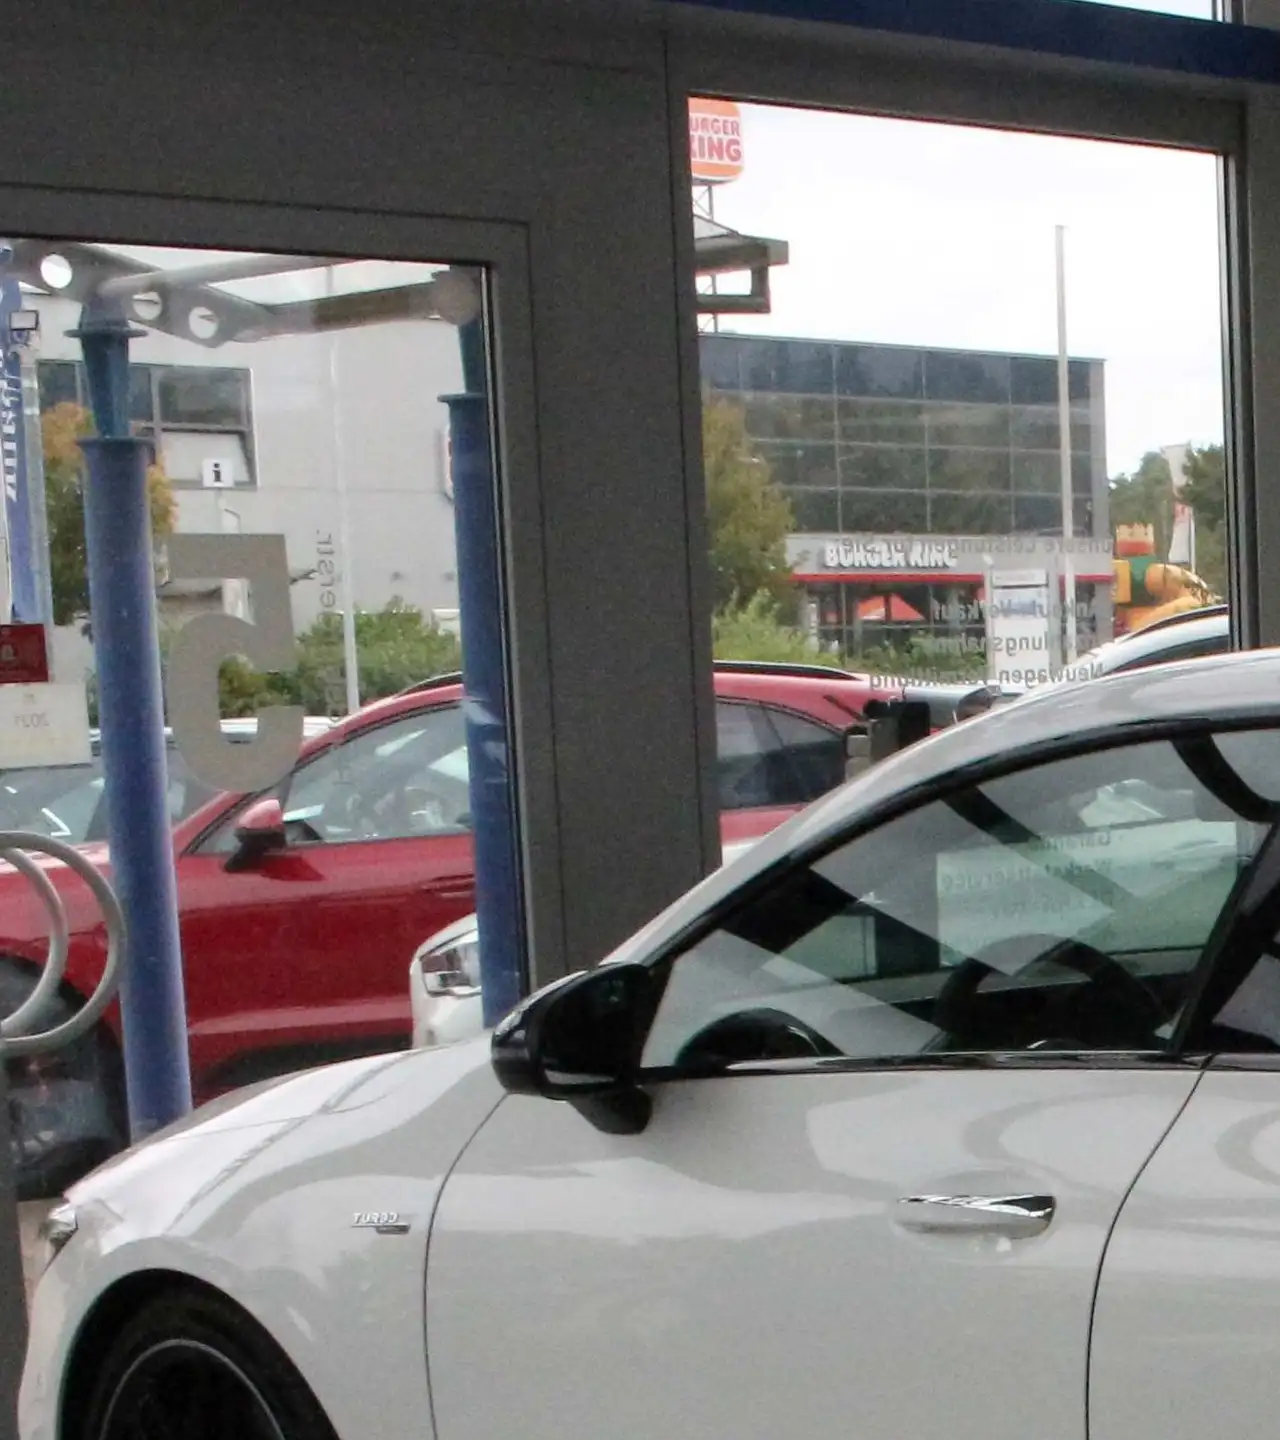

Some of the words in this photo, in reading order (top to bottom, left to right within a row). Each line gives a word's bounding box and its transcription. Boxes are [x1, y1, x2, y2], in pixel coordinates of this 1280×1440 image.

[690, 117, 740, 137] URGER
[824, 542, 907, 569] BURGER
[908, 543, 958, 569] KING
[353, 1212, 399, 1225] TURBO
